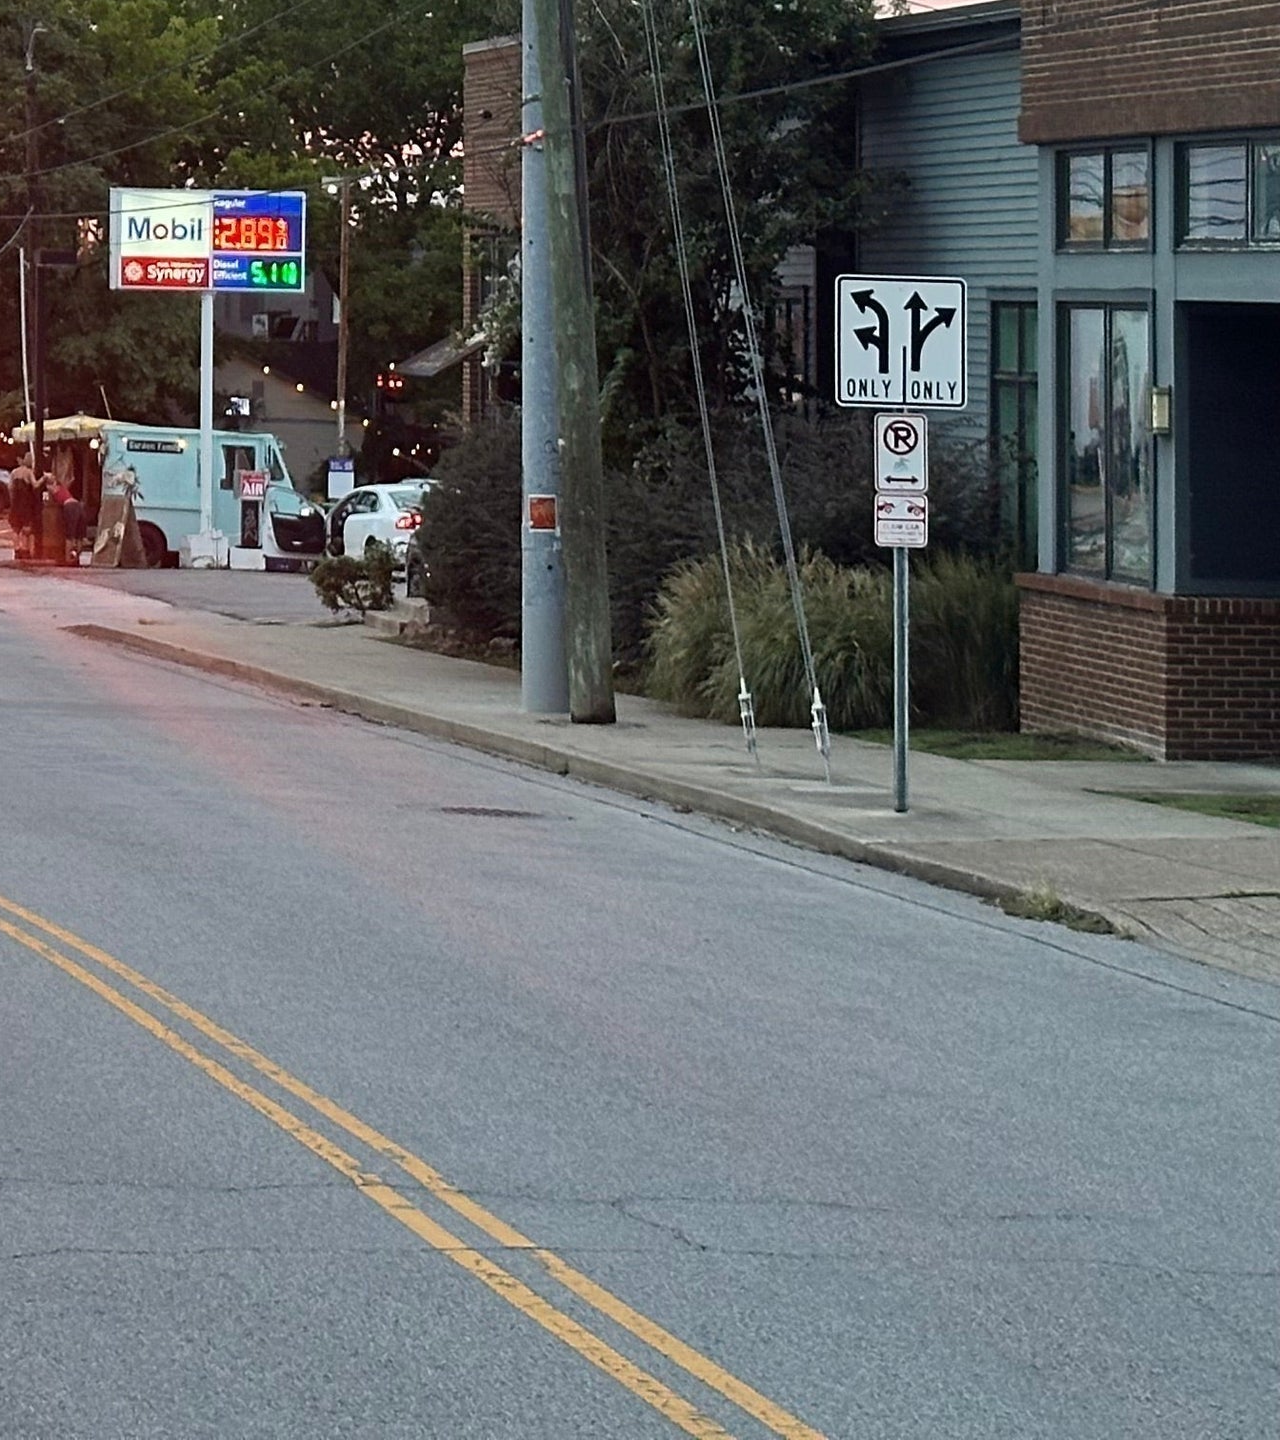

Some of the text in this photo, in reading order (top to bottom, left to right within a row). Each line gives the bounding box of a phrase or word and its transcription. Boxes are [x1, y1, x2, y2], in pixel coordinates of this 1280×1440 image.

[128, 216, 203, 241] Mobil
[213, 259, 239, 269] Diesel
[147, 264, 205, 284] Synergy
[213, 270, 248, 281] Efficient
[847, 378, 957, 400] ONLY ONLY
[242, 481, 264, 496] AIR
